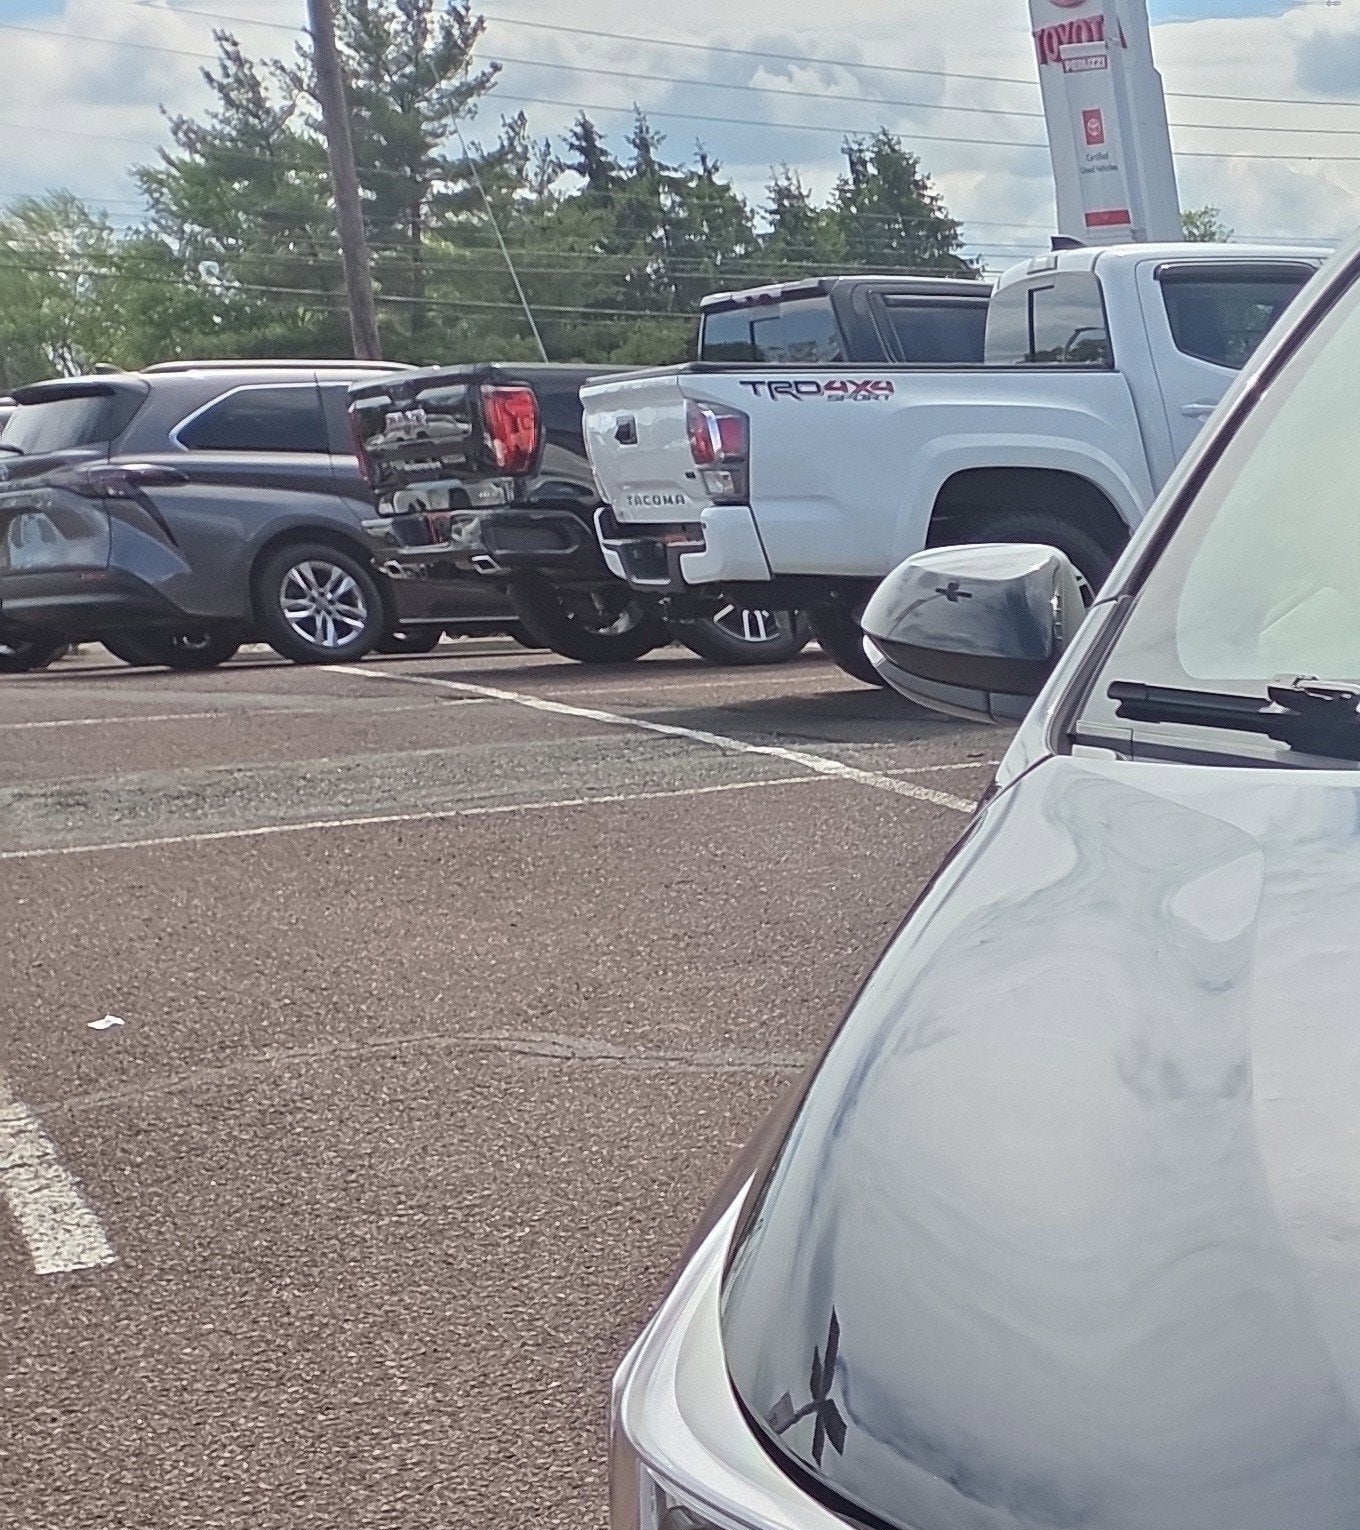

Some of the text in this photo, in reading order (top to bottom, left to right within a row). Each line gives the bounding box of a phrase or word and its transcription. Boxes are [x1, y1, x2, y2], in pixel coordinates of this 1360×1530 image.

[1032, 14, 1127, 65] TOYOT
[739, 380, 822, 401] TRD
[627, 494, 685, 506] TACOMA
